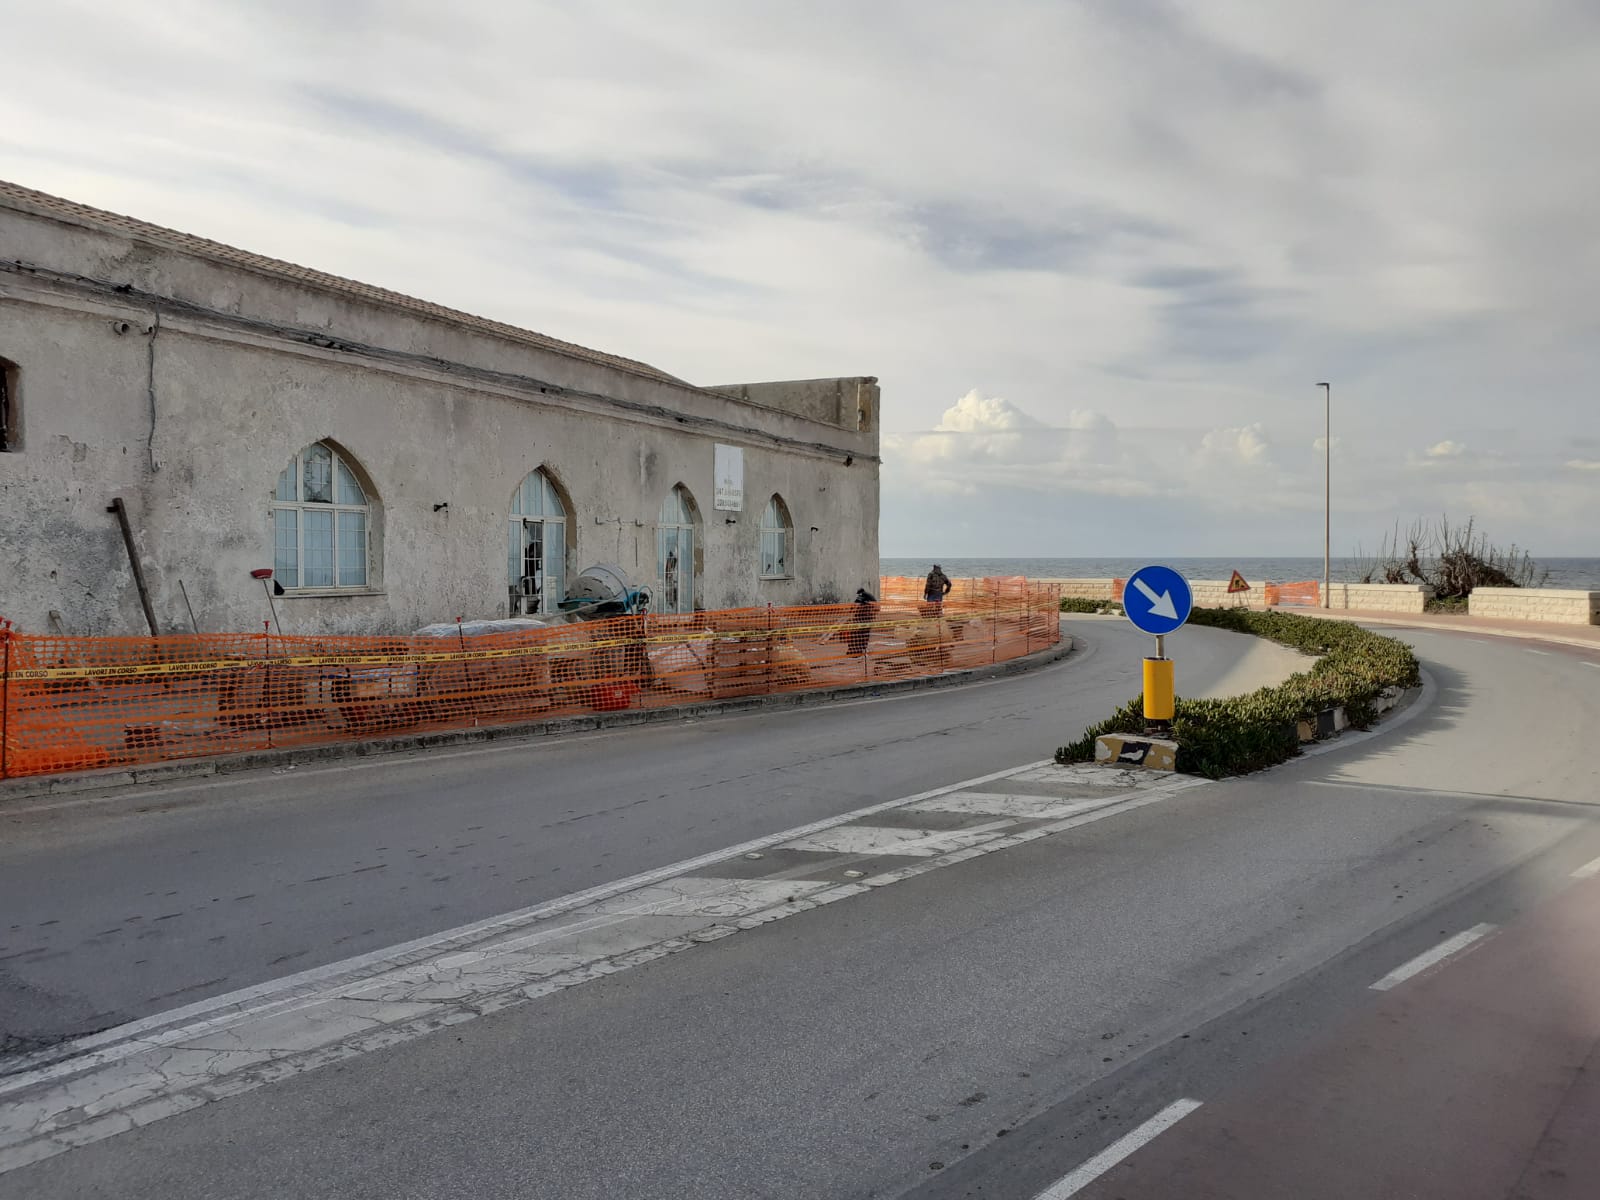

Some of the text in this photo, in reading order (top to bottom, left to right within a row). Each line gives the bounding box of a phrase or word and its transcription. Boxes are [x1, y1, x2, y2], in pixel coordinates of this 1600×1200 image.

[168, 663, 190, 671] LAVORI
[25, 670, 48, 678] CORSO
[84, 668, 107, 676] LAVORI
